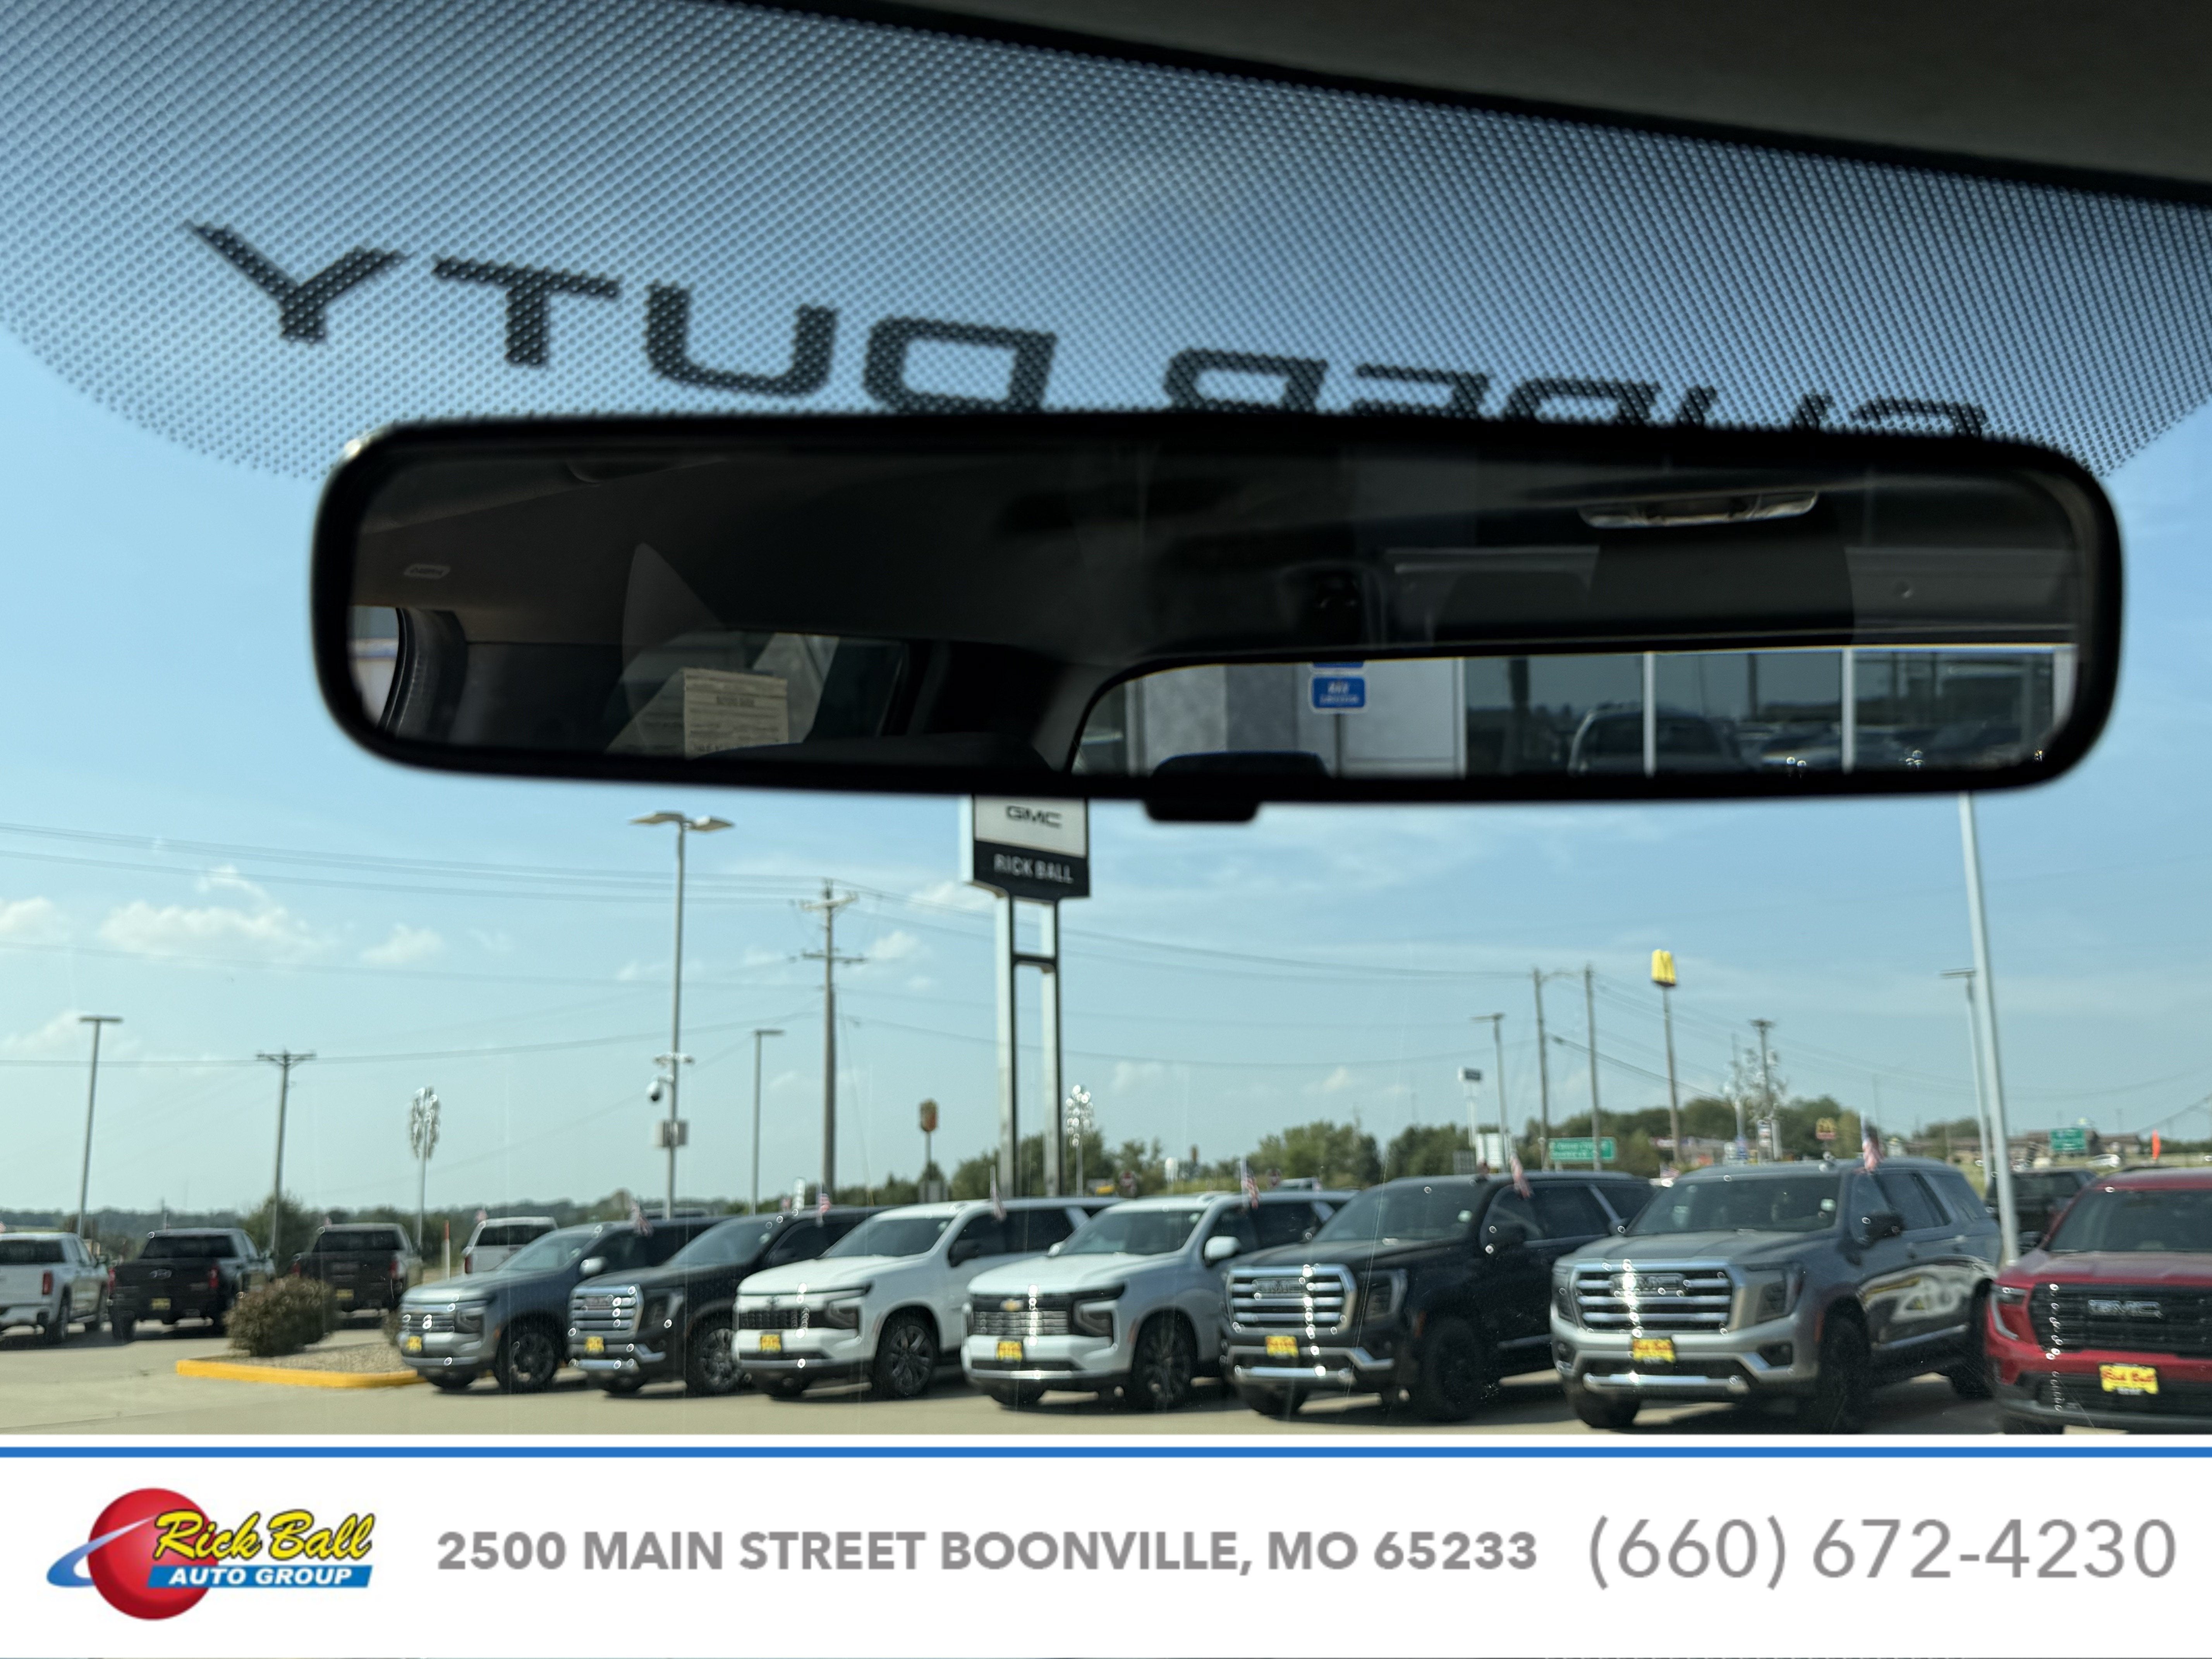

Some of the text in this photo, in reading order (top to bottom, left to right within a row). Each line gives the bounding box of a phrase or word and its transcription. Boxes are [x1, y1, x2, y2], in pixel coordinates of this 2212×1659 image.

[1006, 805, 1061, 829] GMC
[994, 854, 1074, 884] RICK BALL
